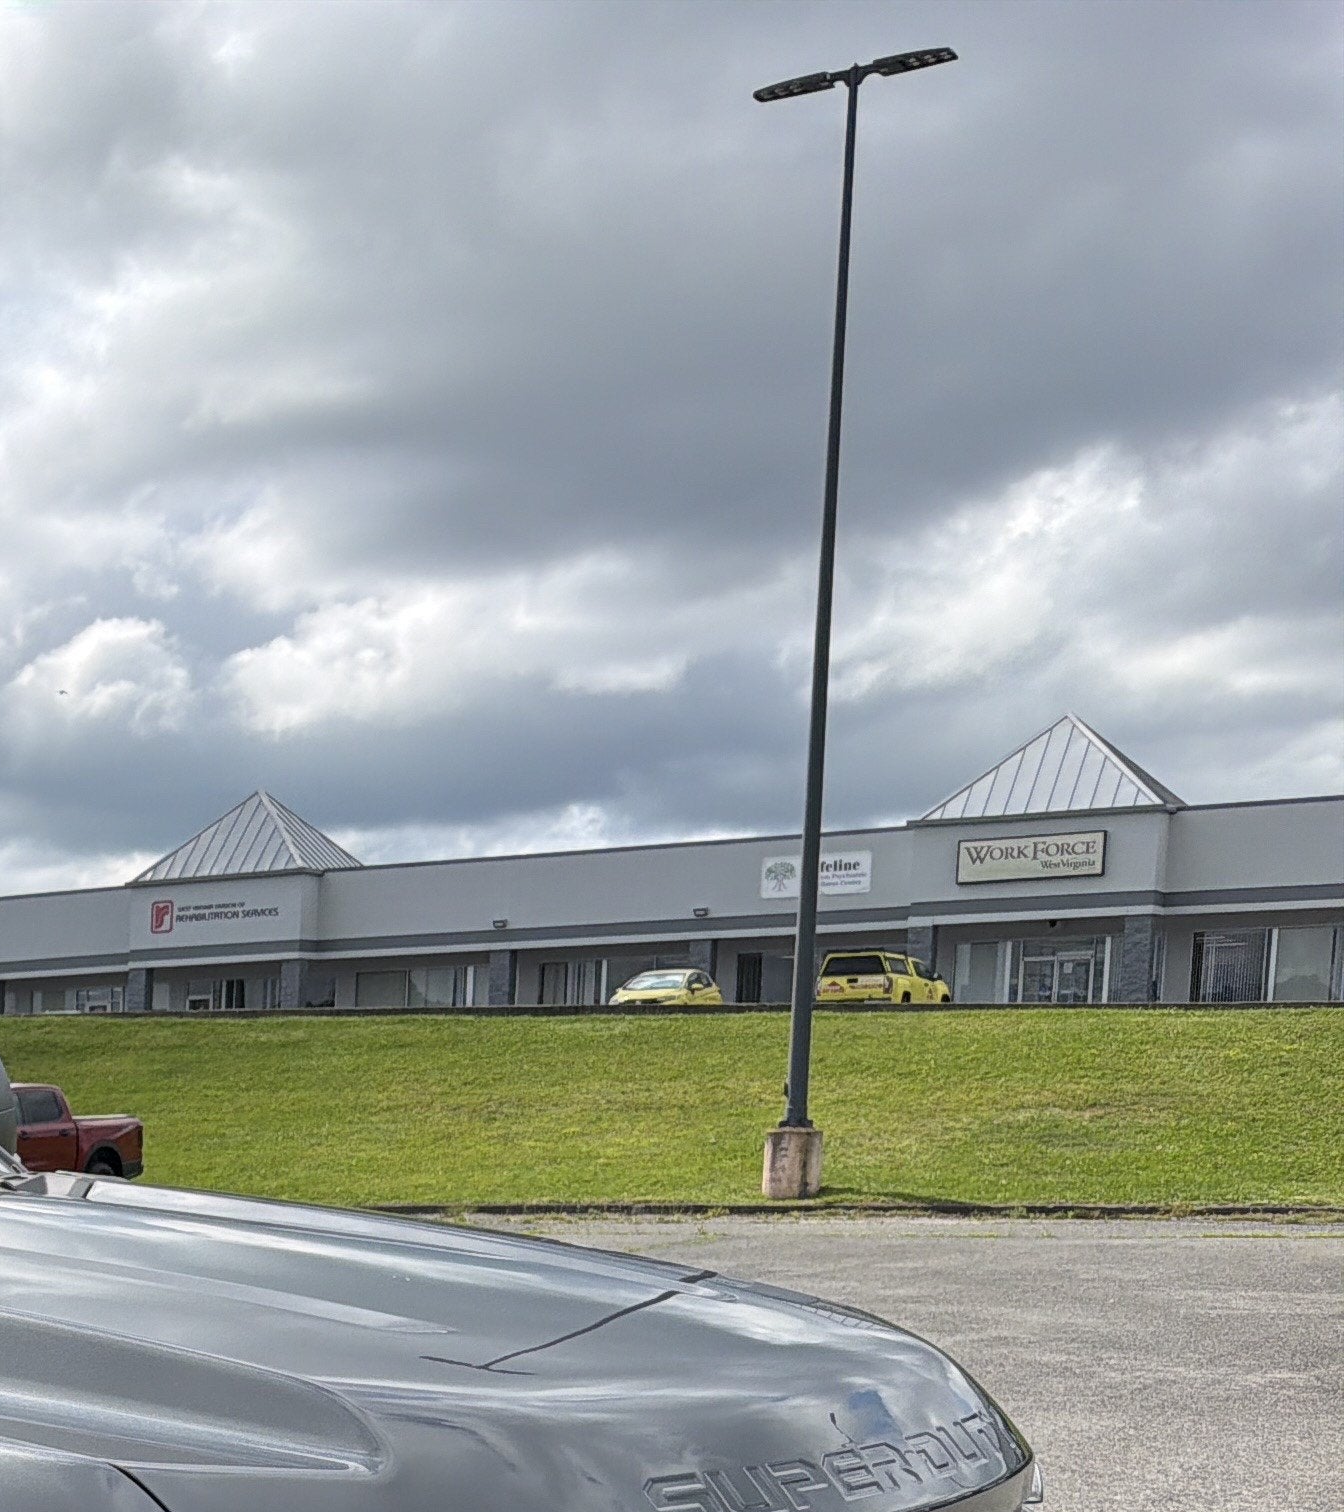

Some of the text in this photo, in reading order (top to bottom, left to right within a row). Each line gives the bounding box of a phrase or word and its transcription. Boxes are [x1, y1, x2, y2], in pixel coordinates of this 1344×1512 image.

[964, 841, 1097, 865] WORK FORCE
[820, 859, 861, 872] feline
